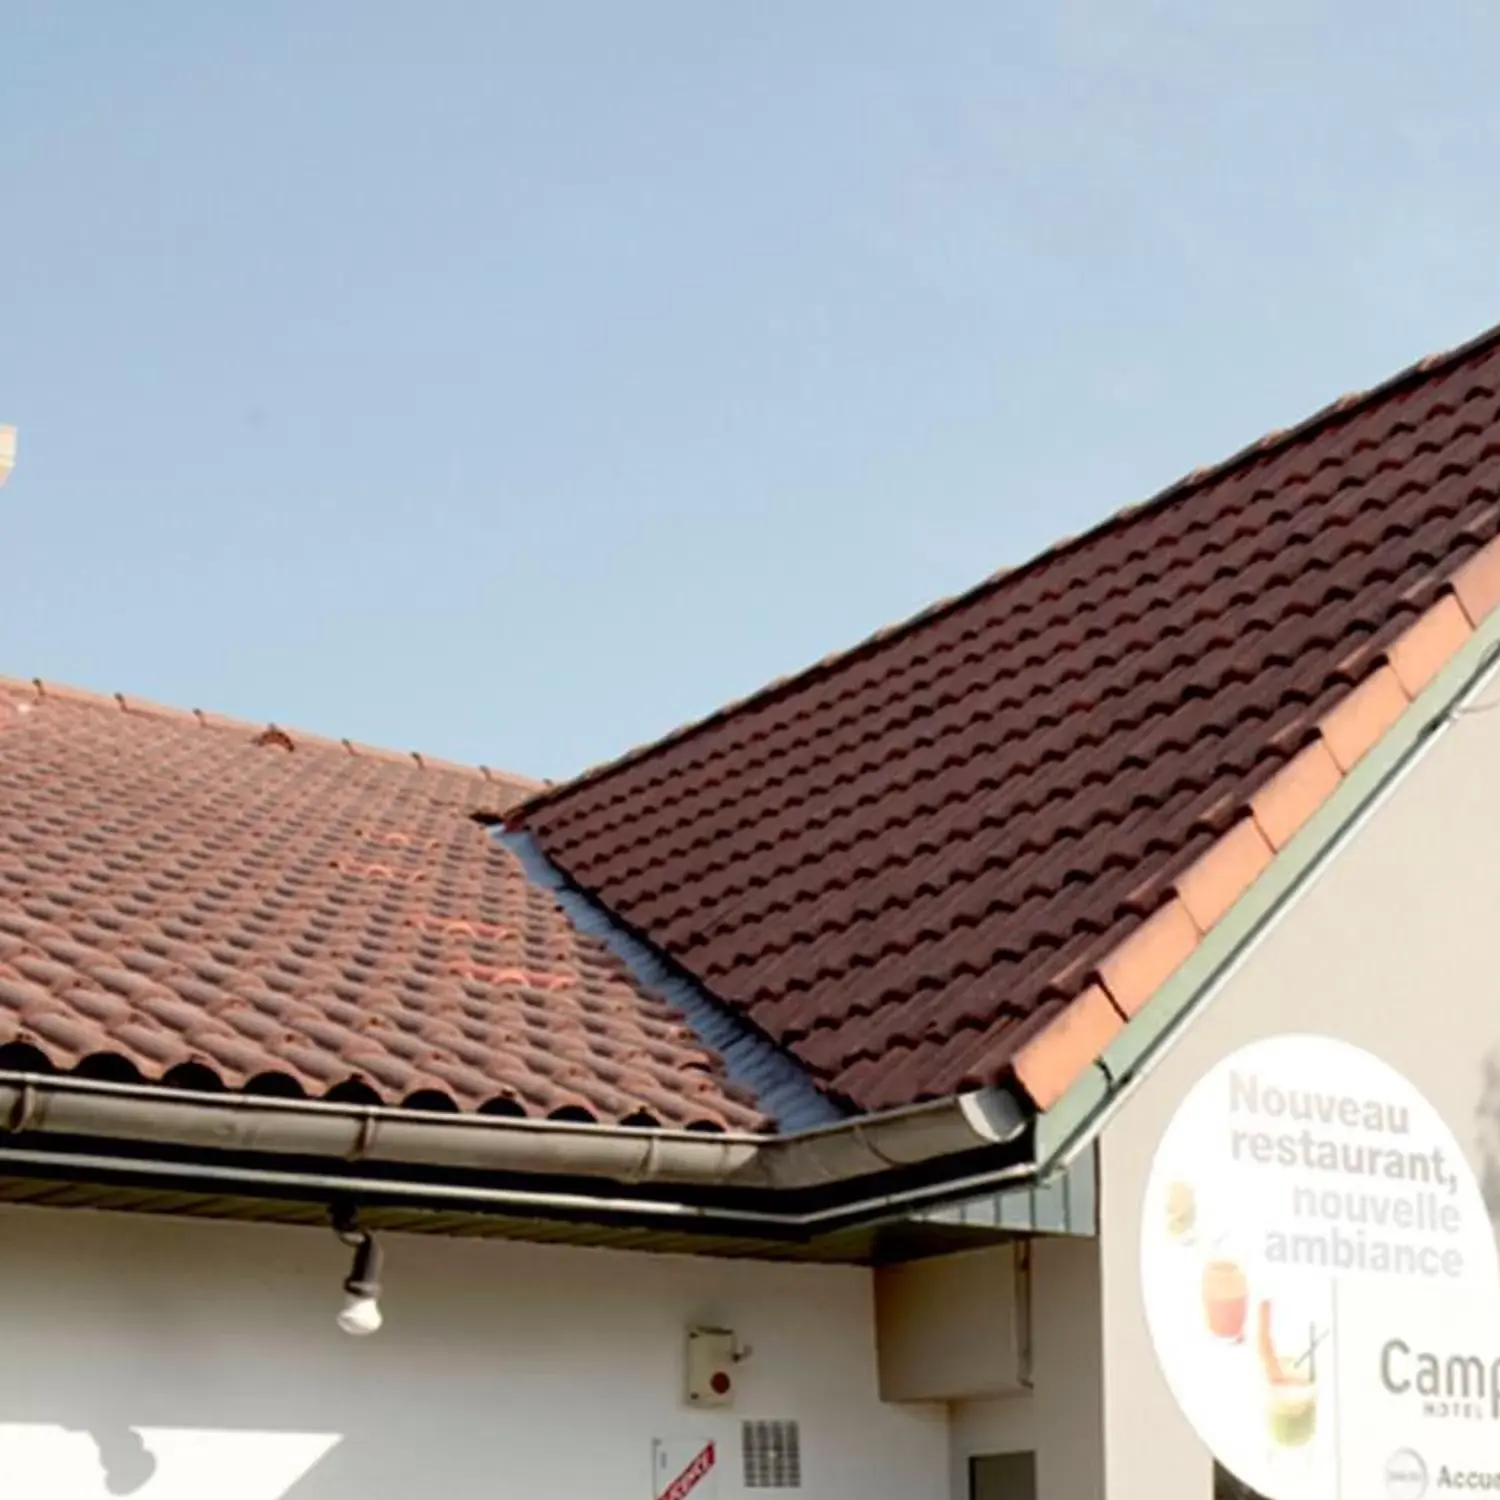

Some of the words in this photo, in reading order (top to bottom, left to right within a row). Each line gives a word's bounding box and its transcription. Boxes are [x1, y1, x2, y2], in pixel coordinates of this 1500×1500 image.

[1229, 1068, 1410, 1135] Nouveau
[1229, 1129, 1458, 1196] restaurant,
[1292, 1183, 1463, 1236] nouvelle
[1264, 1225, 1464, 1279] ambiance
